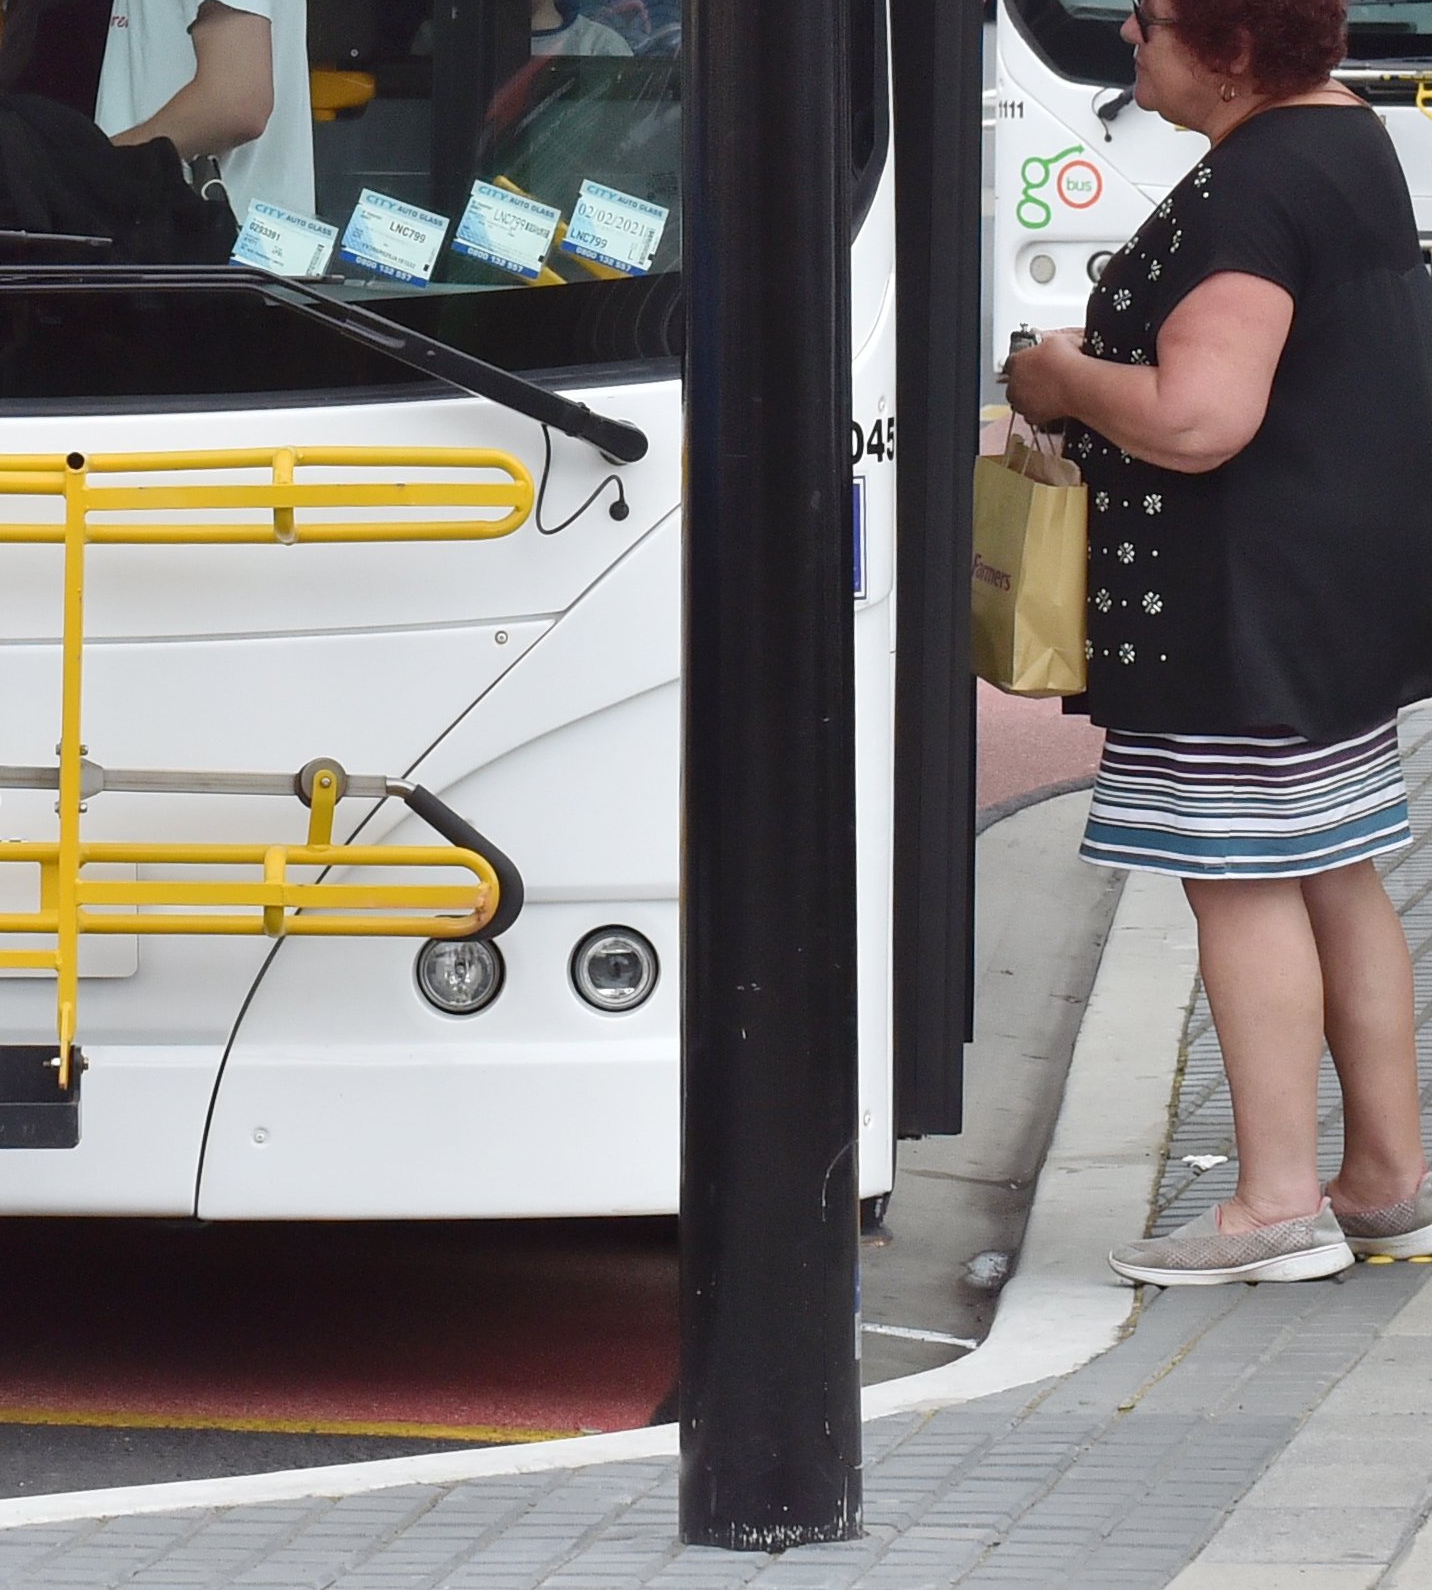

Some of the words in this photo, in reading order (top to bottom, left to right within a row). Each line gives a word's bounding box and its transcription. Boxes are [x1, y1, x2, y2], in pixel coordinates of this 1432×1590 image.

[1066, 178, 1093, 192] bus
[365, 194, 396, 210] CITY
[396, 205, 418, 219] AUTO
[418, 212, 444, 228] GLASS
[478, 185, 508, 202] CITY
[508, 196, 530, 210] AUTO
[531, 203, 555, 219] GLASS
[586, 184, 617, 201] CITY
[617, 195, 638, 209] AUTO
[639, 203, 663, 218] GLASS
[254, 203, 286, 221] CITY
[286, 214, 307, 228] AUTO
[307, 222, 333, 237] GLASS
[493, 209, 526, 230] LNC799
[577, 201, 646, 238] 02/02/2021
[389, 221, 427, 244] LNC799
[569, 228, 608, 249] LNC799
[355, 256, 377, 270] 0800
[379, 263, 395, 275] 132
[467, 247, 489, 261] 0800
[490, 255, 506, 267] 132
[575, 246, 597, 260] 0800
[599, 253, 615, 266] 132
